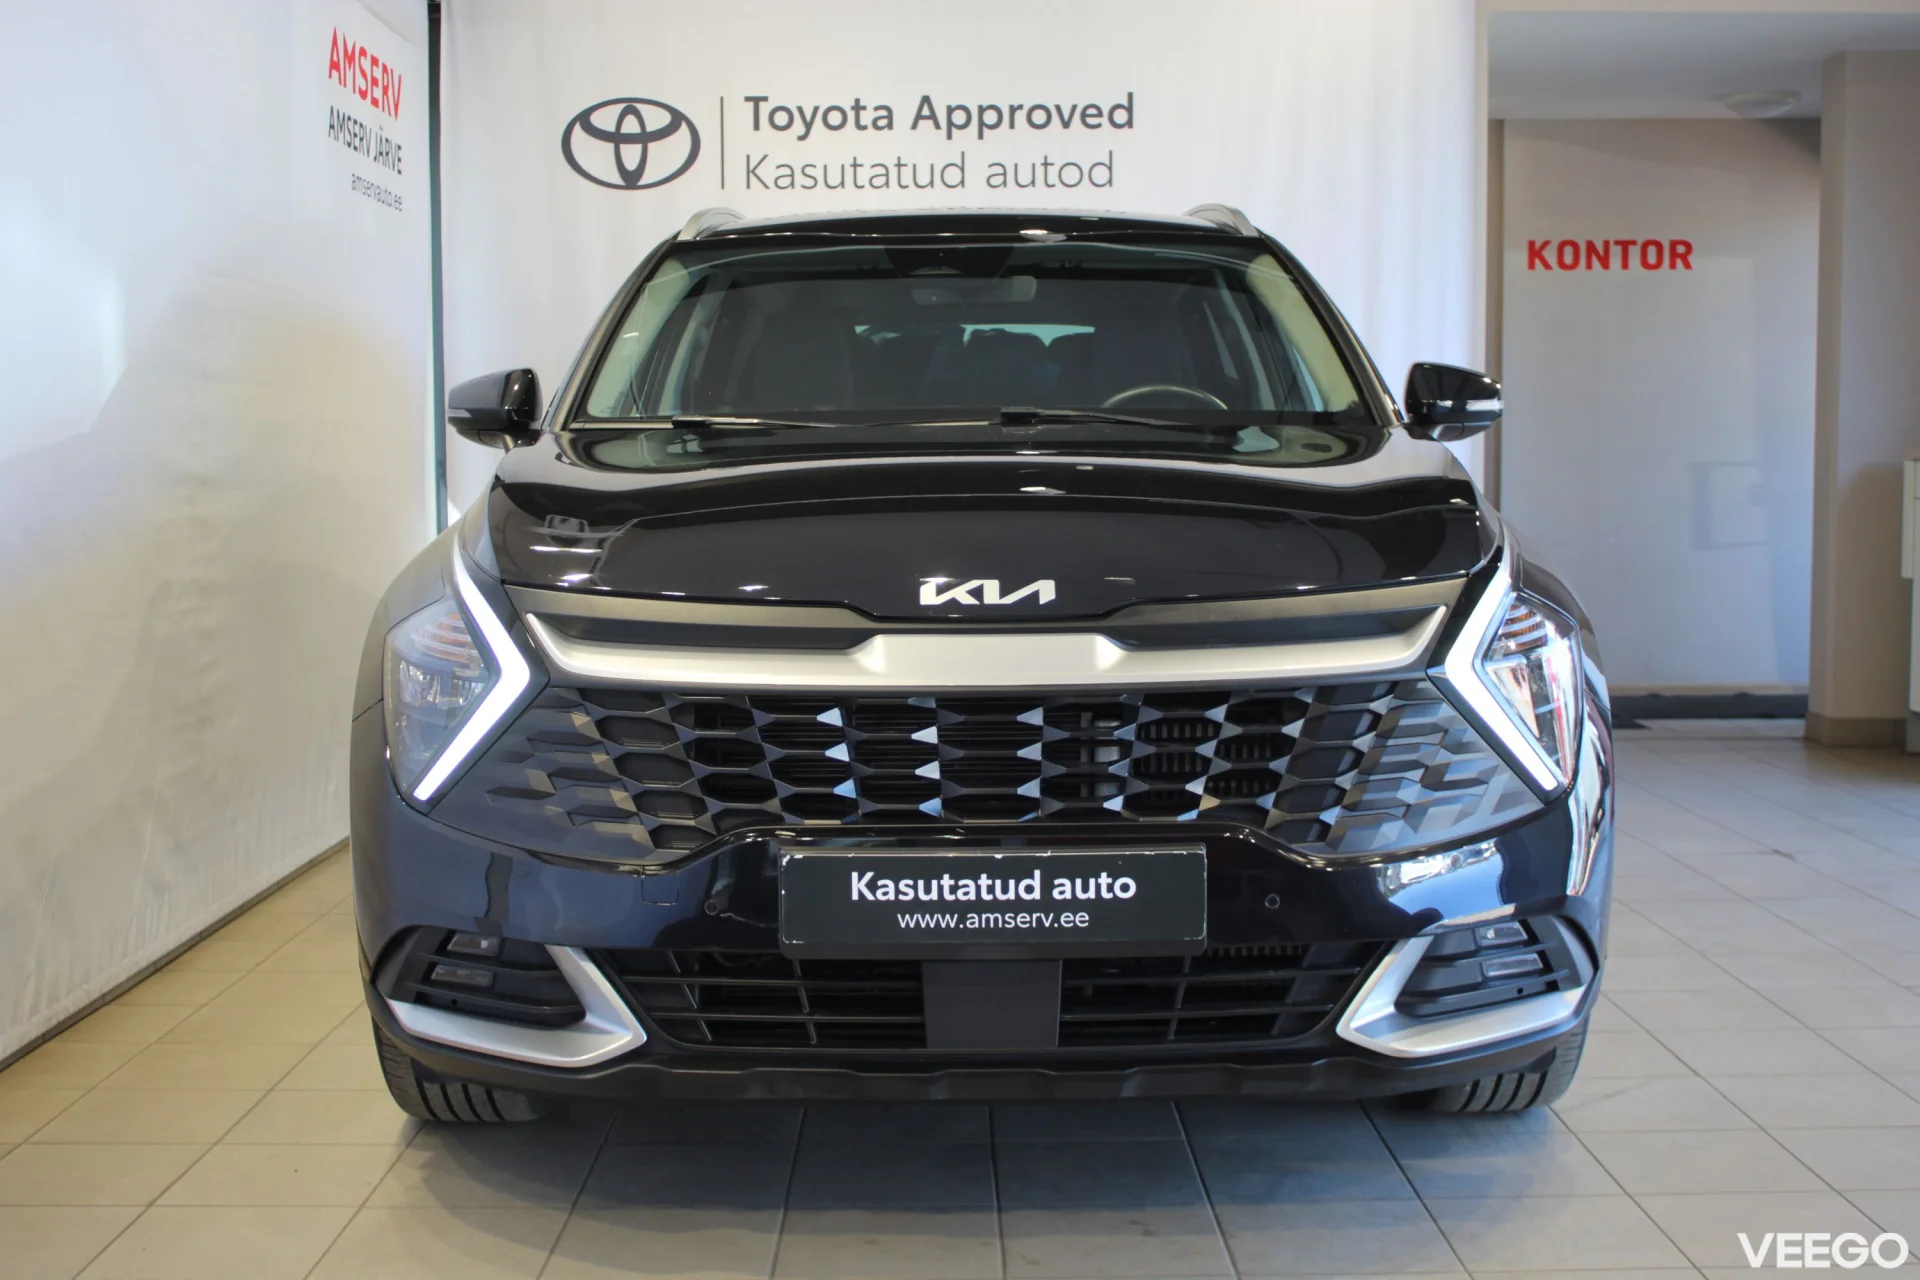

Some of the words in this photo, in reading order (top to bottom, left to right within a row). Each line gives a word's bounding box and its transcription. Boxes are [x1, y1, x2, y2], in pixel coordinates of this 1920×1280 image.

[328, 26, 402, 121] AMSERV
[743, 95, 895, 142] Toyota
[910, 91, 1135, 141] Approved
[328, 105, 372, 158] AMSERV
[373, 124, 402, 175] JÄRVE
[746, 151, 966, 190] Kasutatud
[985, 150, 1114, 189] autod
[351, 173, 403, 212] amservauto.ee
[1527, 239, 1694, 271] KONTOR
[919, 578, 1056, 605] KIA
[851, 869, 1041, 902] Kasutatud
[1052, 871, 1137, 901] auto
[897, 911, 1090, 929] www.amserv.ee
